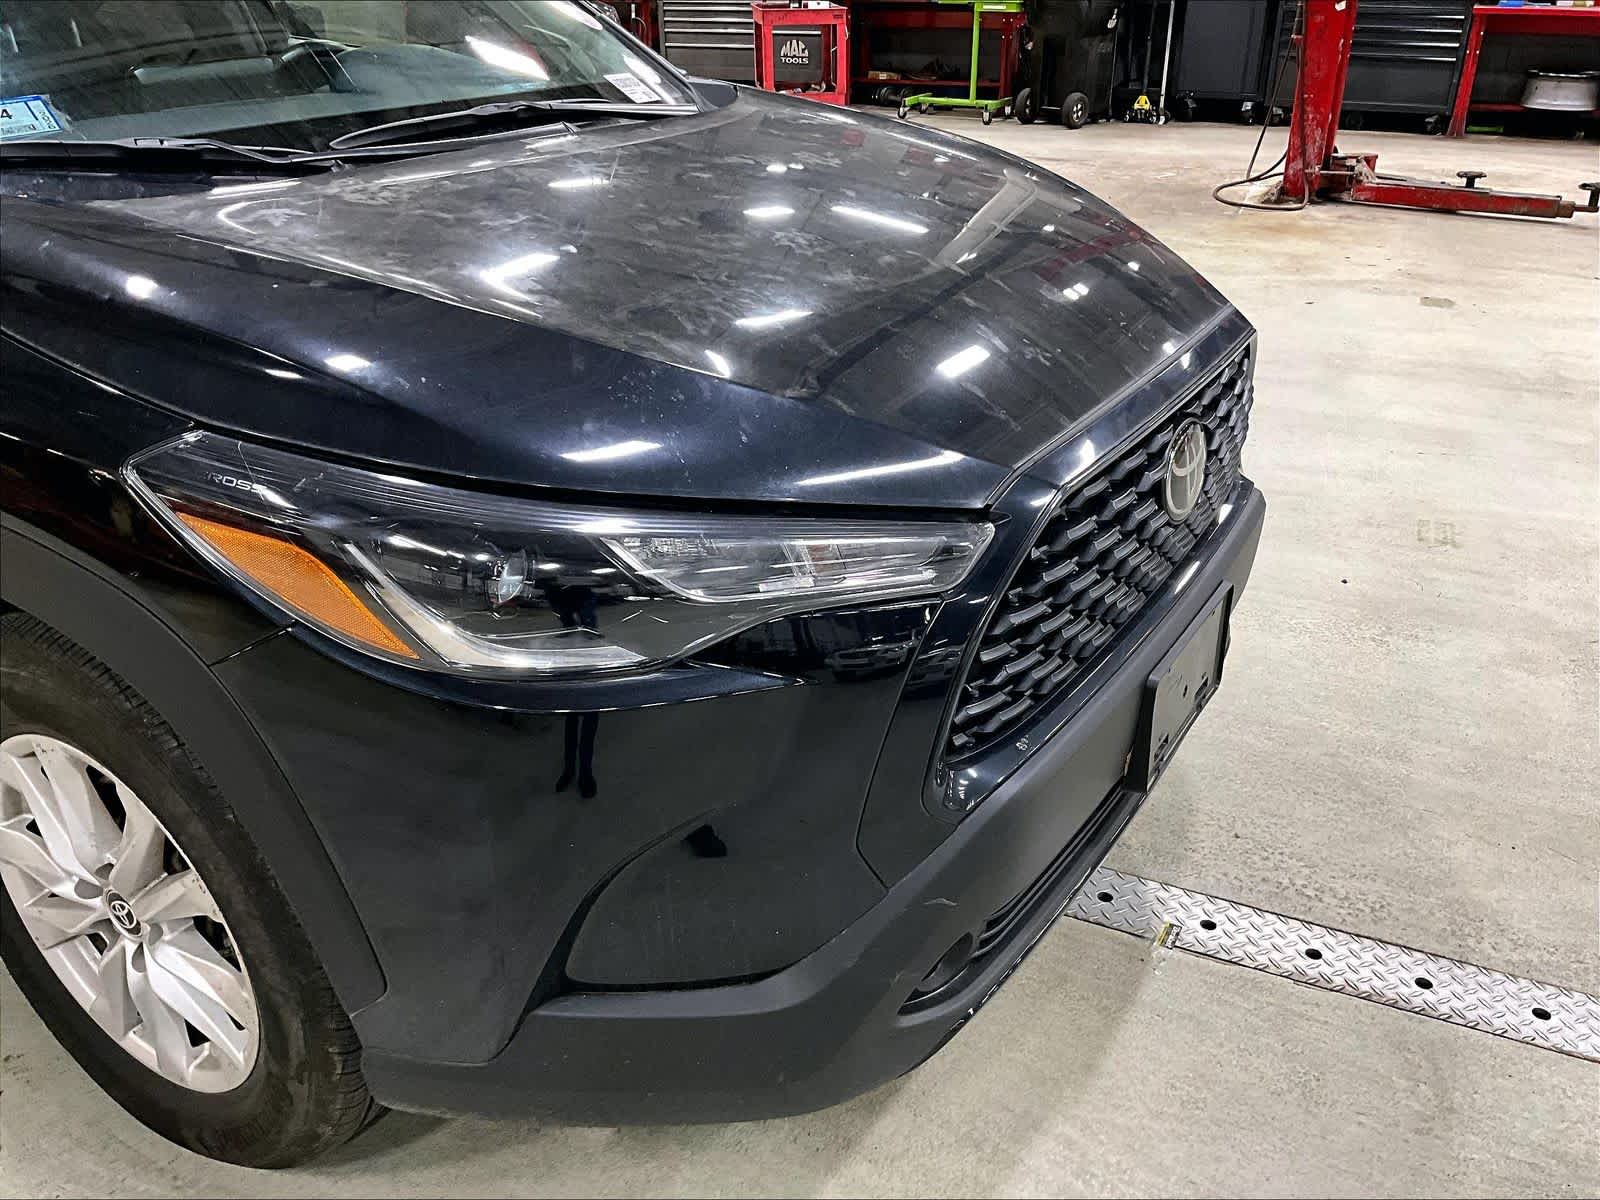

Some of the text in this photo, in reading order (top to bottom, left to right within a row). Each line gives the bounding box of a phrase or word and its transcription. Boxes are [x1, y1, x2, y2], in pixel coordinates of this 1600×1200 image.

[780, 39, 808, 56] MAC
[0, 109, 12, 119] 4
[206, 471, 267, 494] ROSS
